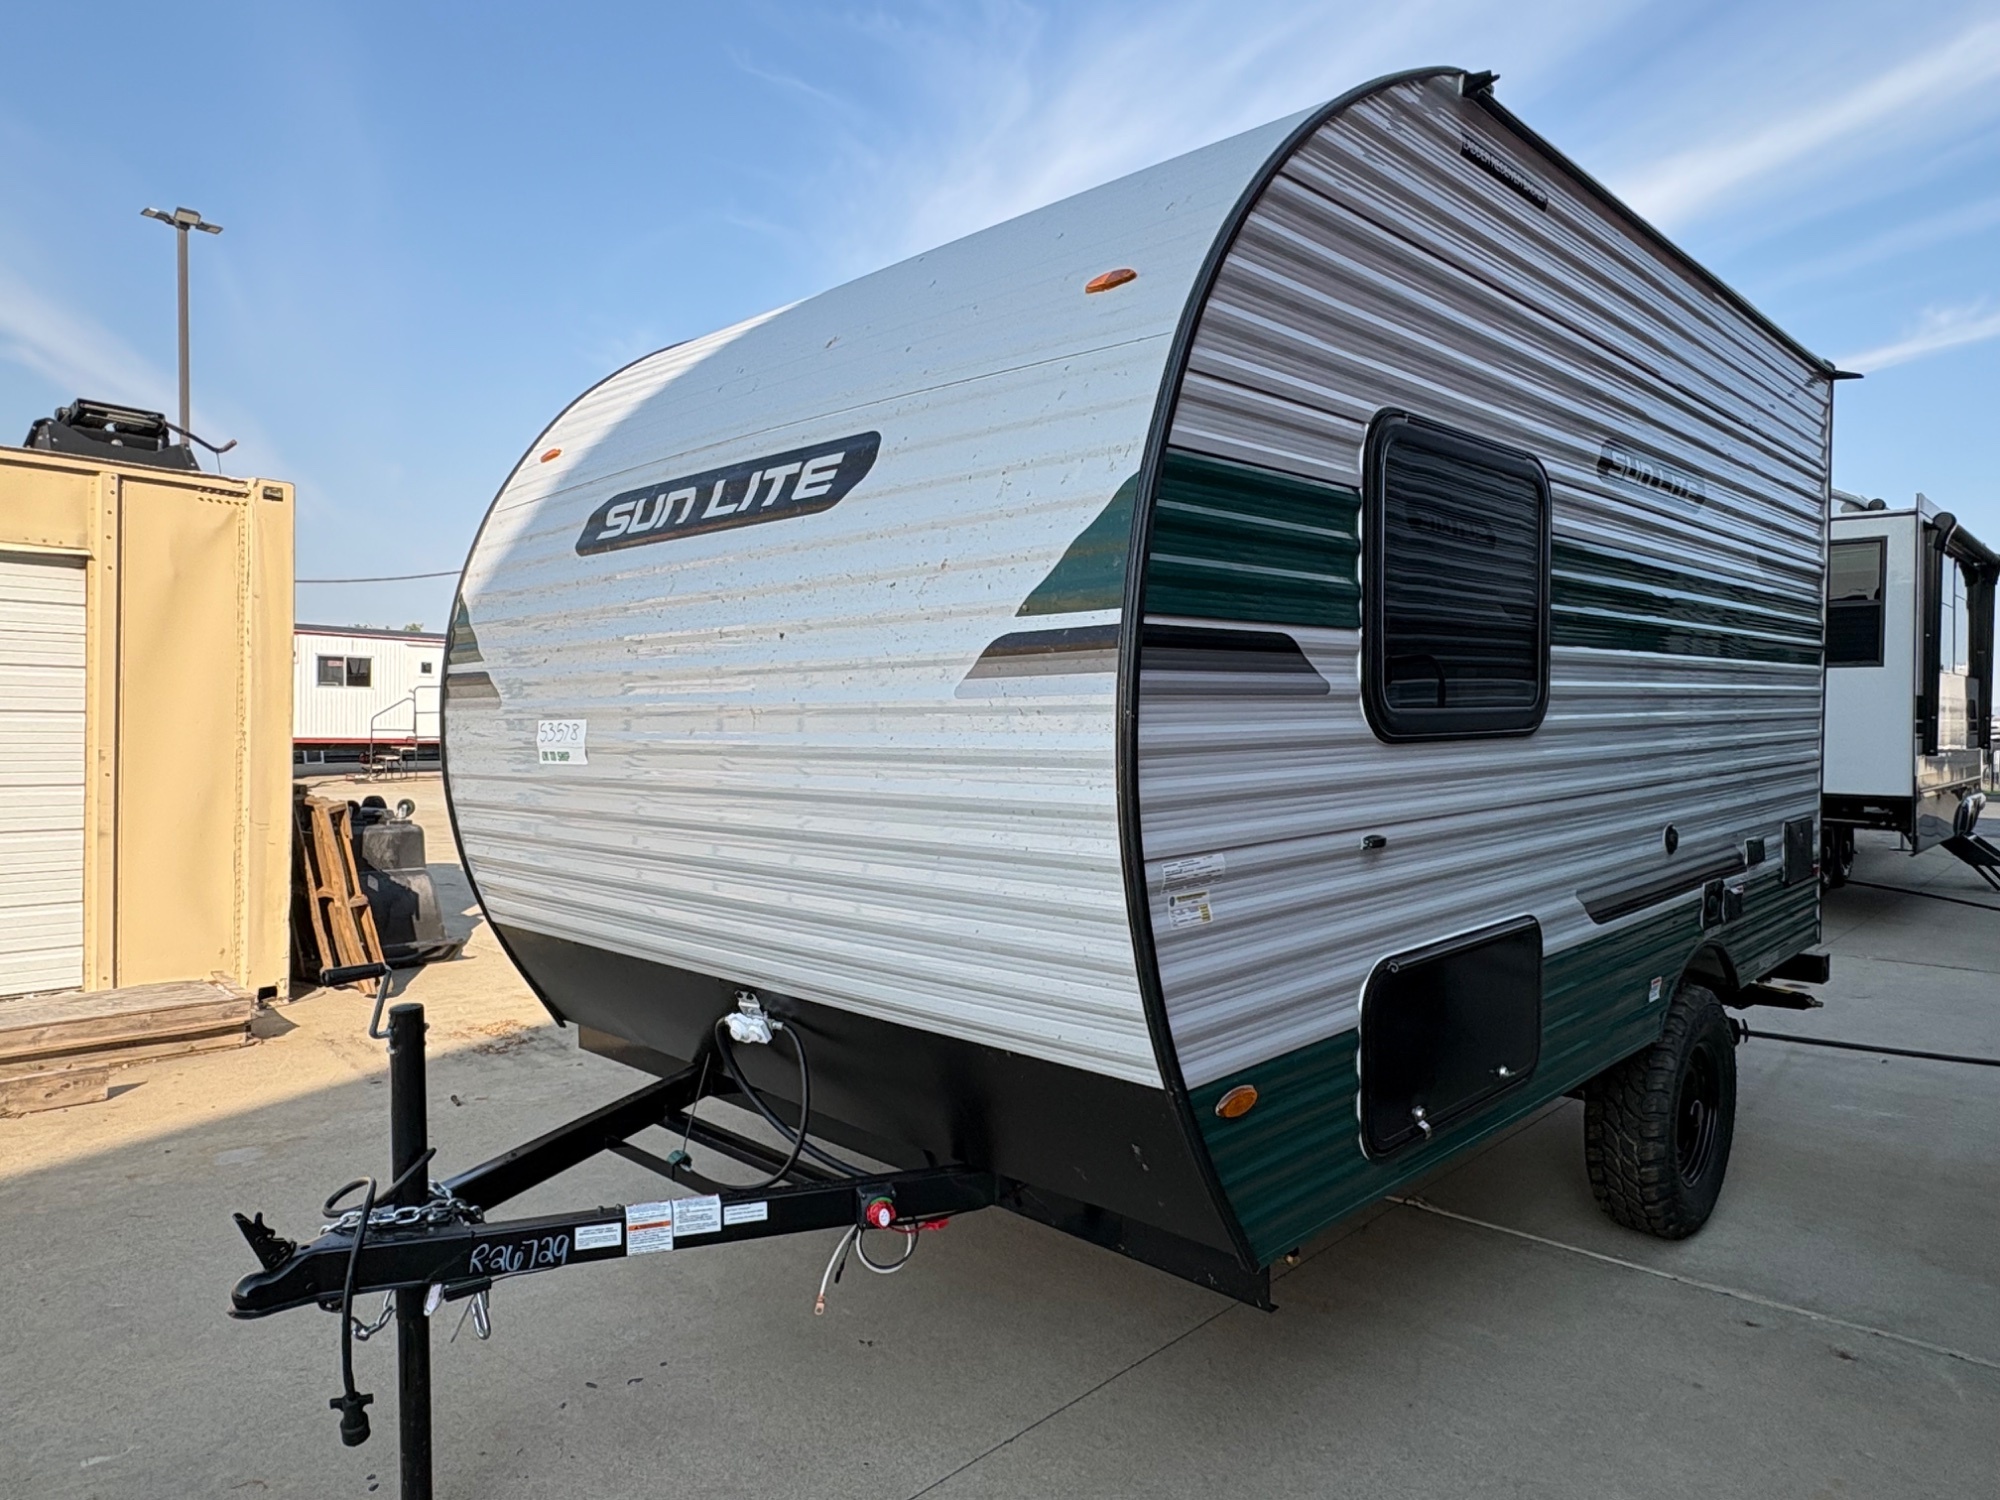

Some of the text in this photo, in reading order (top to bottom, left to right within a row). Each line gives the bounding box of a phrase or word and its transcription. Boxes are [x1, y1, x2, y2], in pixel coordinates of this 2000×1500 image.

[1606, 450, 1655, 488] SUN
[595, 451, 846, 541] SUN LITE
[540, 722, 580, 742] 53578
